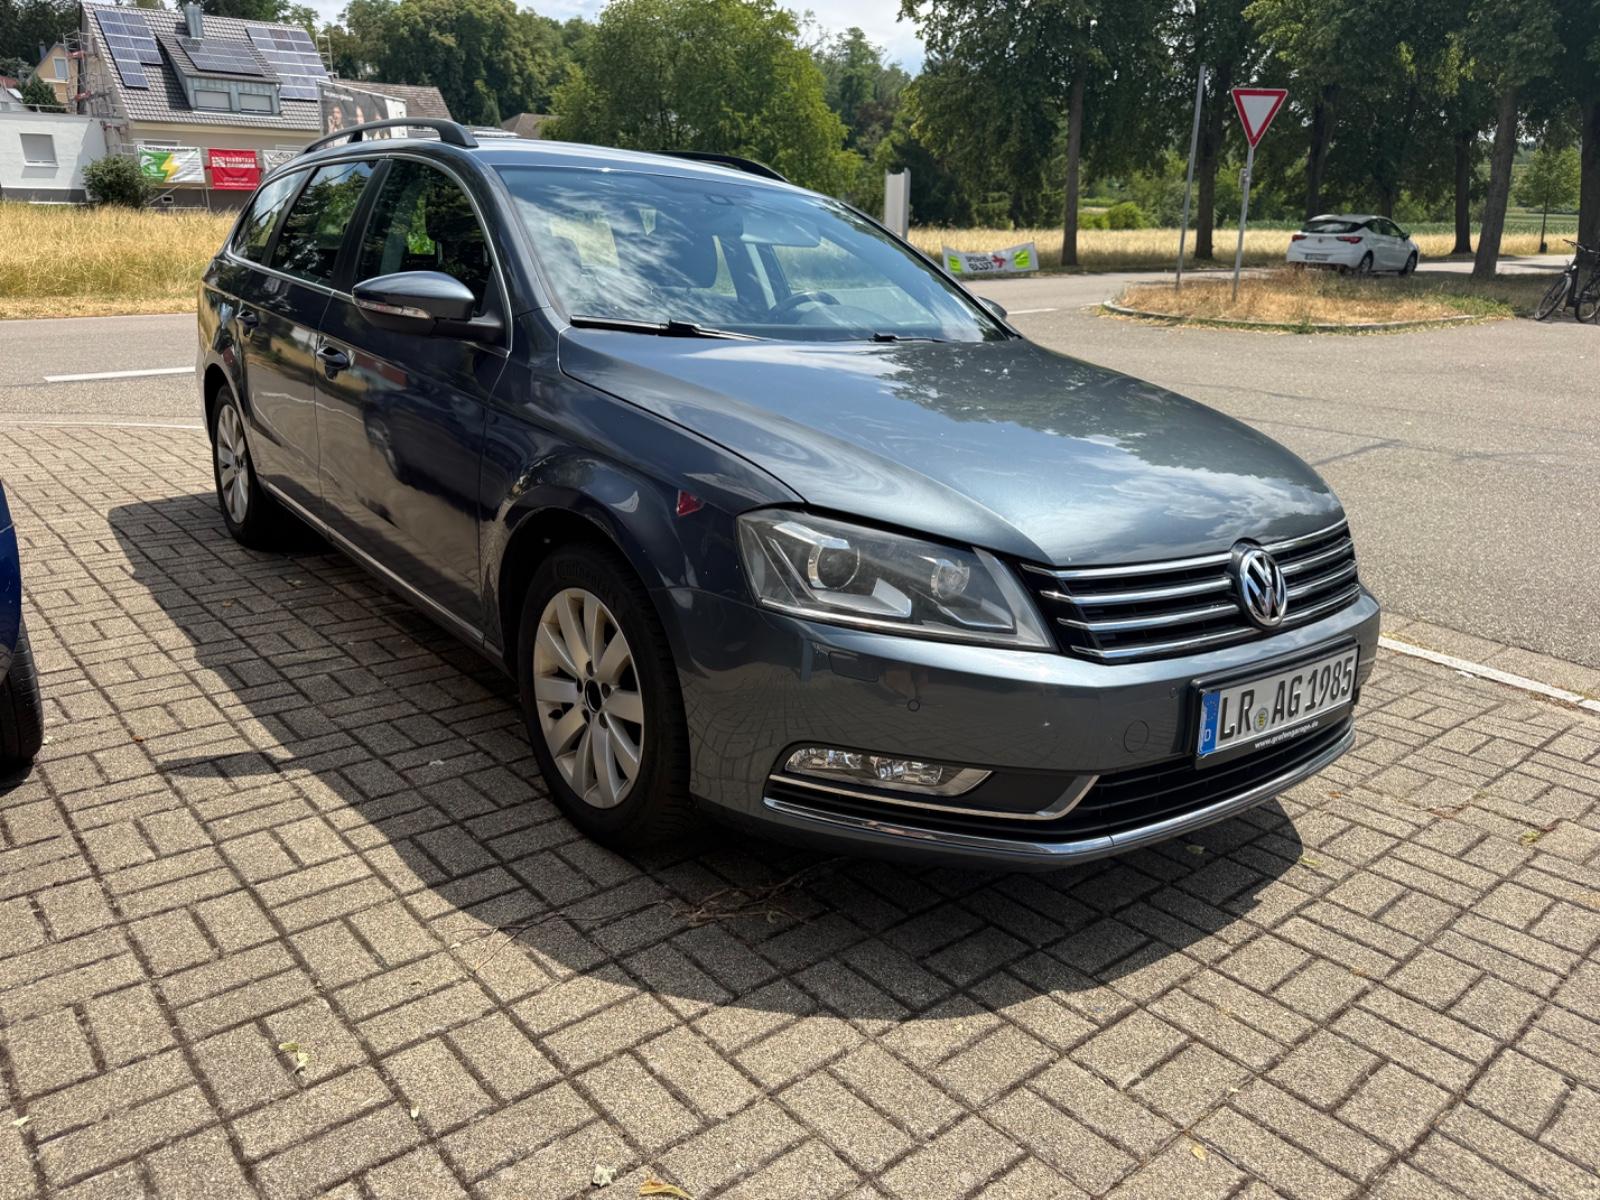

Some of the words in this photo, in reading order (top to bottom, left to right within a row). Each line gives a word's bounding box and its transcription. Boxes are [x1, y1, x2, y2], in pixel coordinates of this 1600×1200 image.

[1240, 551, 1287, 626] VW
[1204, 728, 1212, 742] D
[1219, 689, 1255, 741] LR
